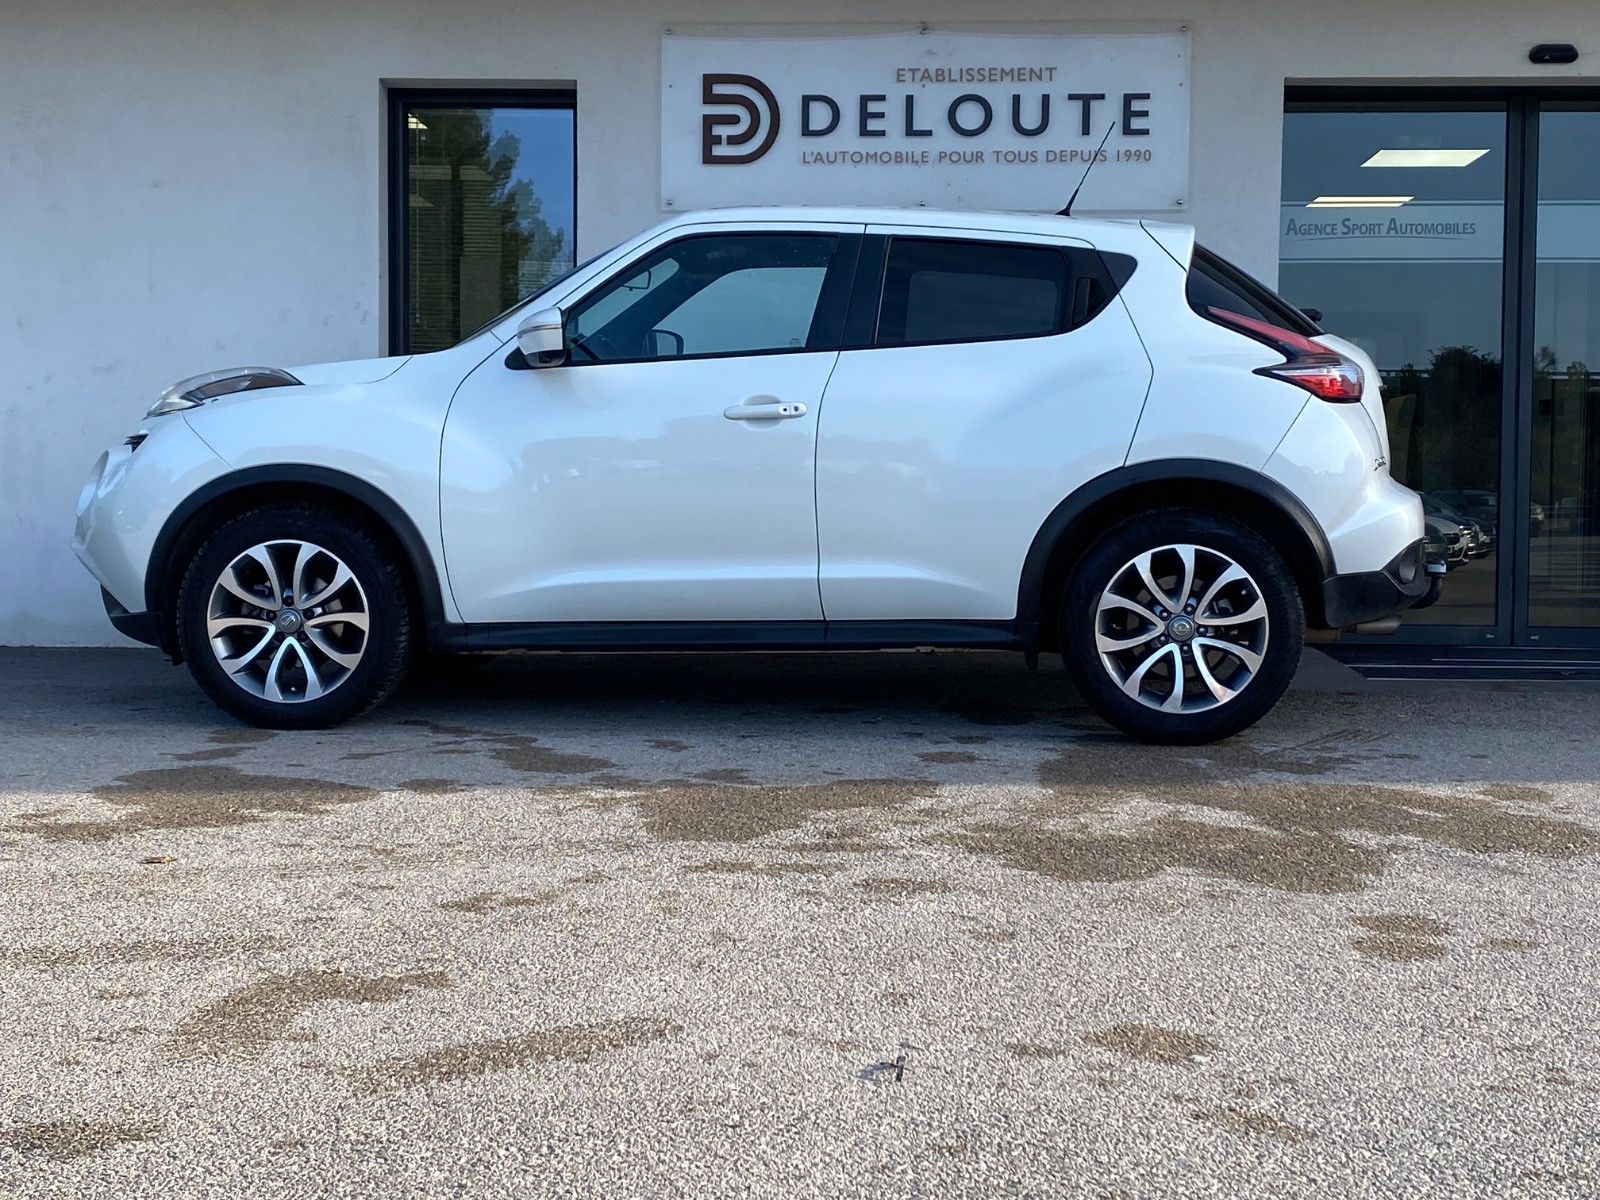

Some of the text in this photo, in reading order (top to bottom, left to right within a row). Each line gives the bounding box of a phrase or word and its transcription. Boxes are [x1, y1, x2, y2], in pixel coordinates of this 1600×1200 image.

[896, 67, 1058, 83] ETABLISSEMENT
[801, 92, 1151, 137] DELOUTE
[802, 150, 930, 164] L'AUTOMOBILE
[938, 150, 985, 164] POUR
[992, 150, 1039, 164] TOUS
[1116, 149, 1152, 162] 1990
